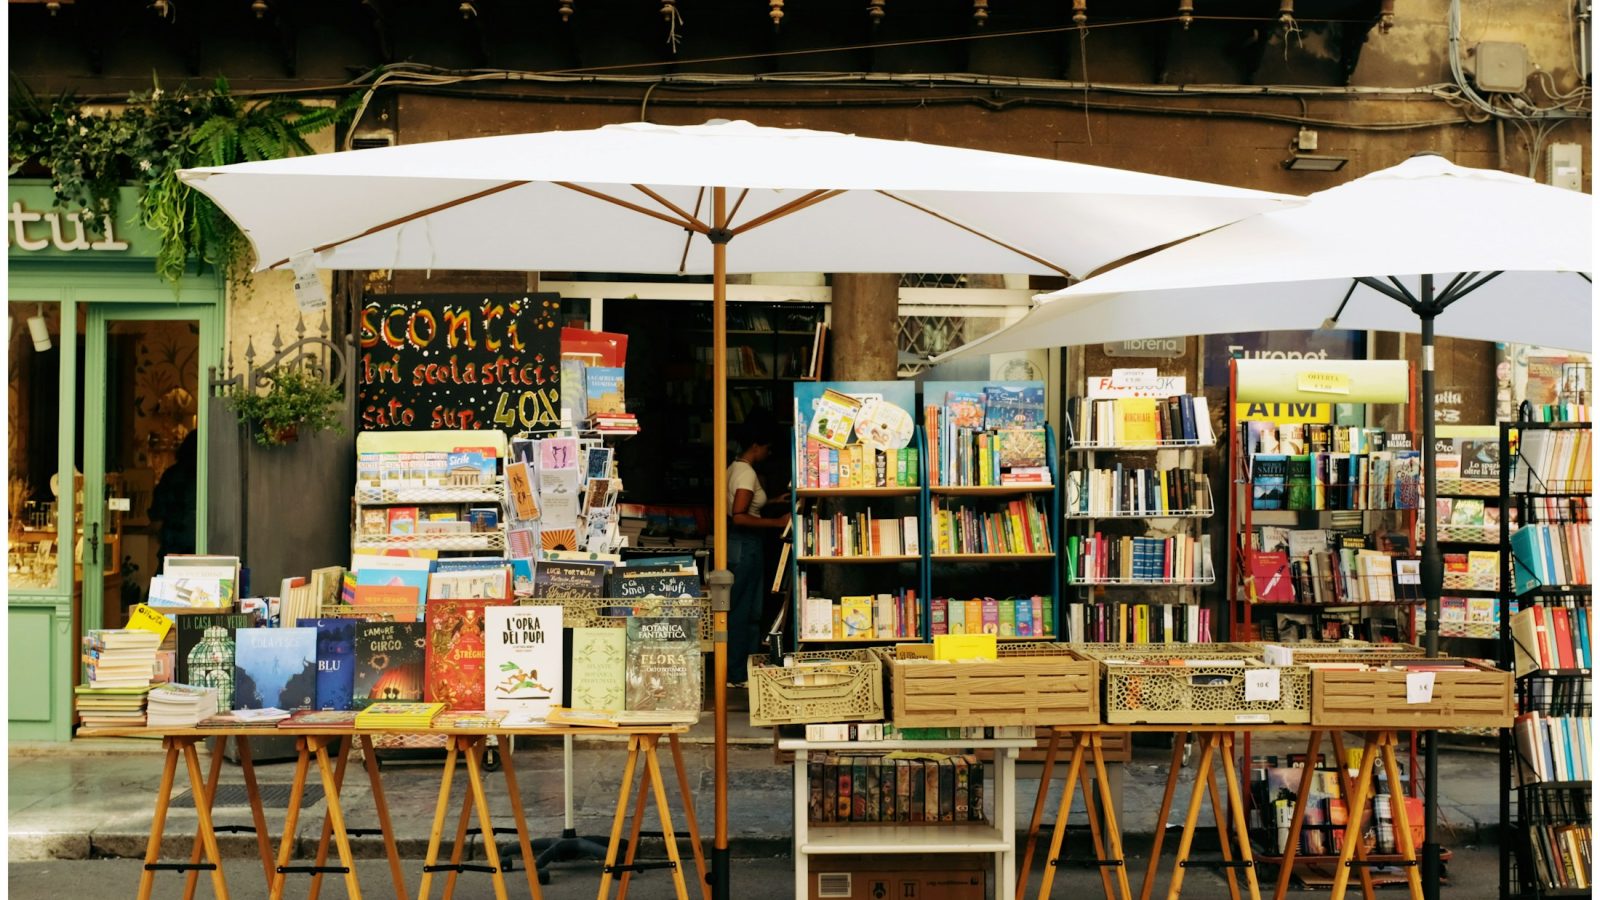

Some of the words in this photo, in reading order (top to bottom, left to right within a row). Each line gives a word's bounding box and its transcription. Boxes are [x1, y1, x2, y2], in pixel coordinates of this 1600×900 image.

[8, 201, 128, 250] tui
[1246, 402, 1317, 417] ATM
[1470, 460, 1480, 468] Lo
[194, 615, 212, 630] CASA
[227, 614, 248, 629] VETRO
[506, 617, 541, 631] L'OPRA
[641, 624, 683, 632] BOTANICA
[364, 625, 395, 637] L'AMORE
[638, 631, 687, 639] FANTASTICA
[503, 631, 518, 645] DEI
[523, 630, 545, 645] PUPI
[370, 639, 402, 652] CIRCO
[318, 660, 341, 671] BLU
[640, 654, 687, 665] FLORA
